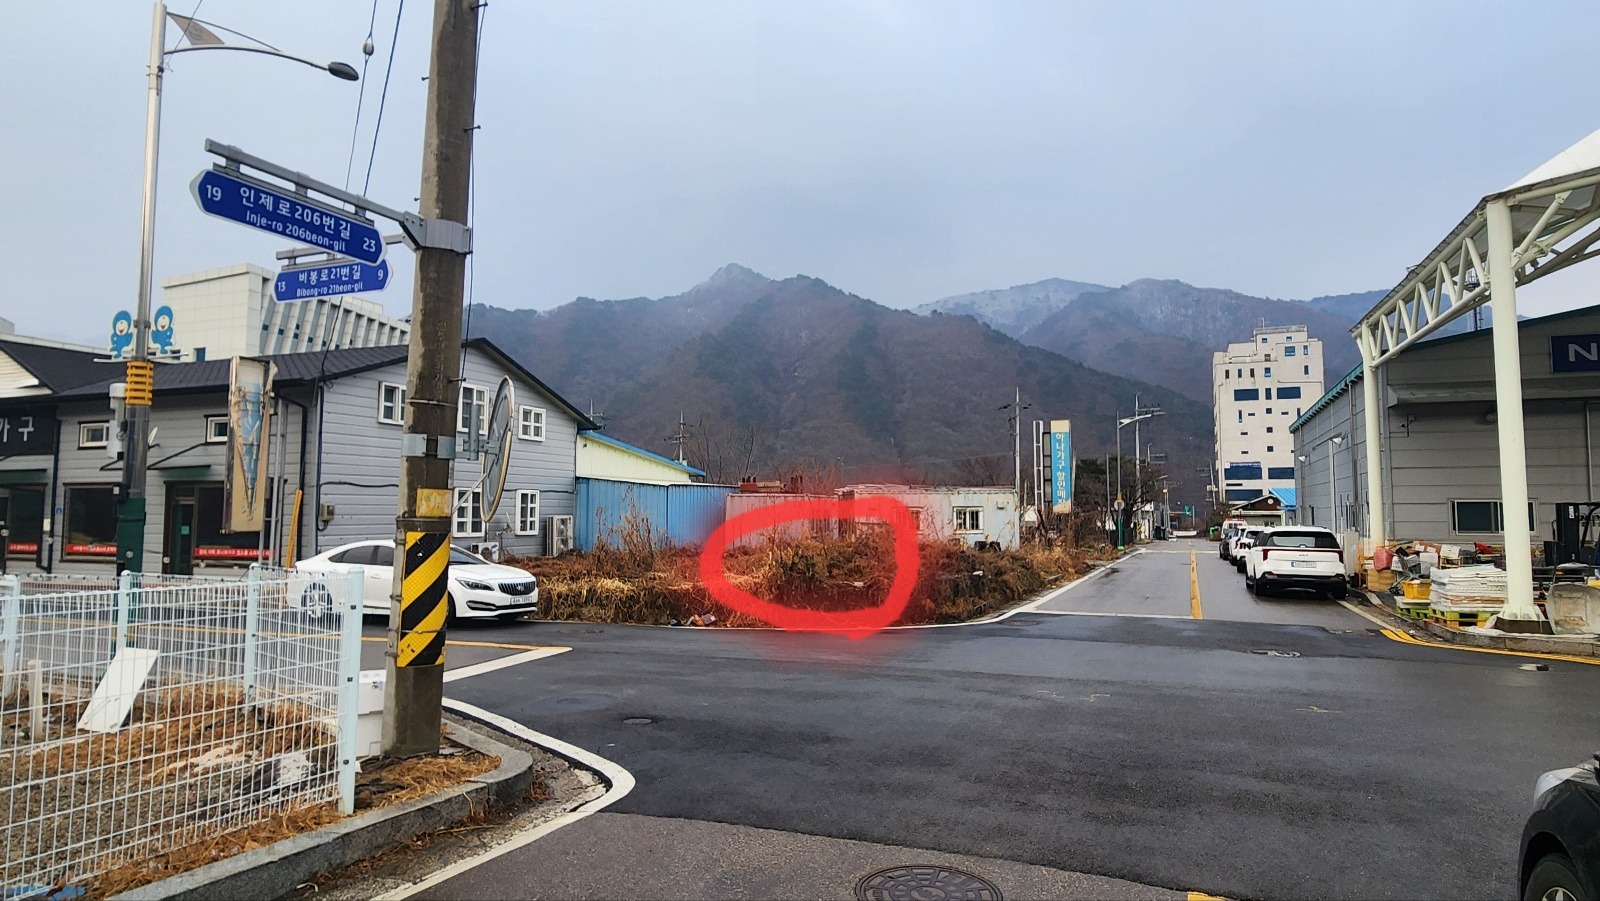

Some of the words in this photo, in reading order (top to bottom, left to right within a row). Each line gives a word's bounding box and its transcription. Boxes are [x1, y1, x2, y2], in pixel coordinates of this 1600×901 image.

[205, 184, 222, 201] 19
[240, 186, 351, 240] 인제로206번길
[246, 210, 283, 232] Inje-ro
[285, 223, 346, 252] 206beon-gil
[362, 237, 376, 252] 23
[298, 264, 361, 285] 비봉로21번길
[377, 269, 384, 280] 9
[277, 281, 286, 292] 13
[296, 286, 328, 297] Bibong-ro
[328, 281, 363, 294] 21beon-gil
